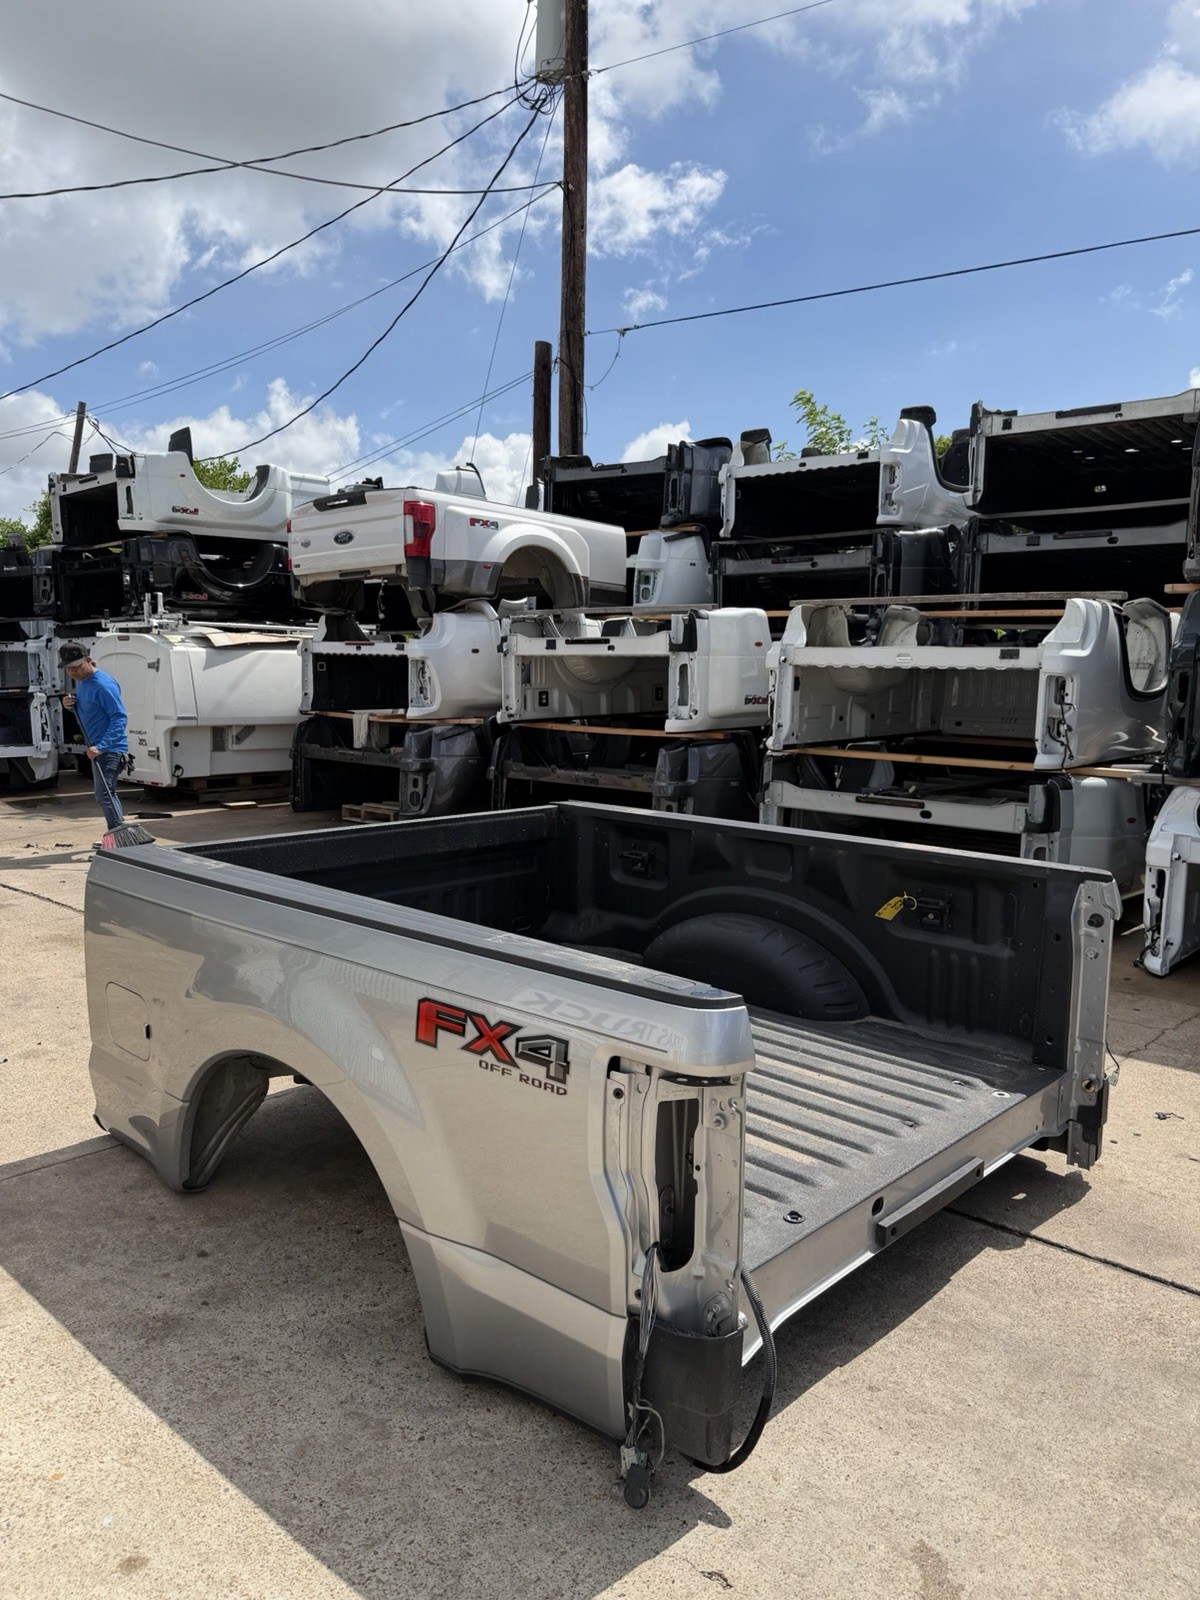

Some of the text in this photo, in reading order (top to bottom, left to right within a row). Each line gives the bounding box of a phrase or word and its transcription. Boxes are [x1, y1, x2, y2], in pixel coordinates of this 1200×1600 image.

[470, 517, 499, 530] FX4
[415, 996, 570, 1085] FX4
[478, 1058, 569, 1096] OFF ROAD
